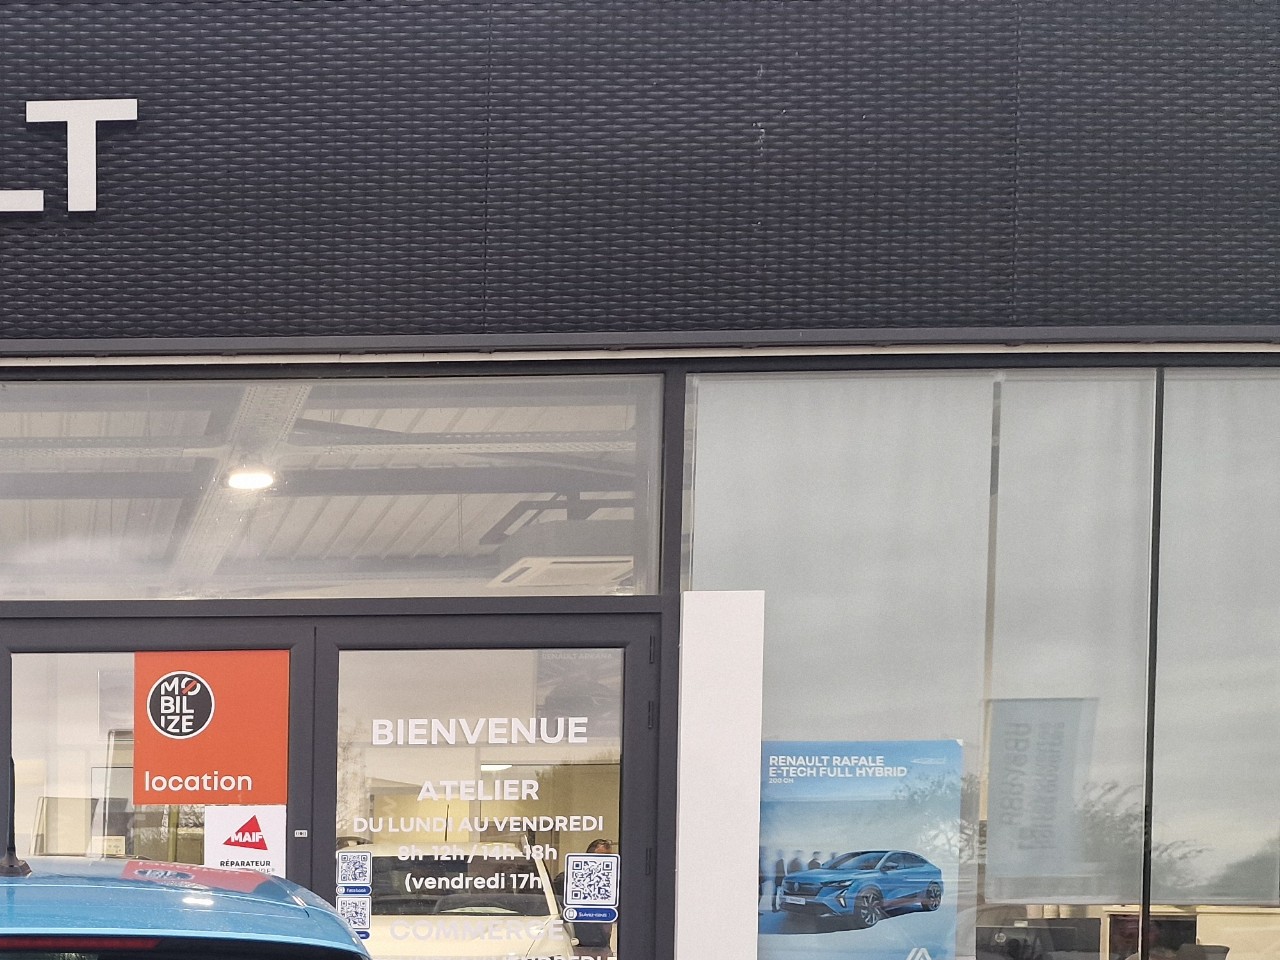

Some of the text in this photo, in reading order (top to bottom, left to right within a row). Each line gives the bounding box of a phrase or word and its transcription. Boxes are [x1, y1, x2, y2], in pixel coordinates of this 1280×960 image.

[372, 717, 589, 746] BIENVENUE
[769, 756, 885, 766] RENAULT RAFALE
[144, 771, 253, 791] location
[769, 766, 908, 777] E-TECH FULL HYBRID
[417, 779, 540, 801] ATELIER
[353, 815, 604, 833] DU LUNDI AU VENDREDI
[230, 832, 263, 843] MAIF
[220, 859, 271, 867] RÉPARATEUR
[404, 872, 506, 893] (vendredi
[389, 919, 564, 942] COMMERCE
